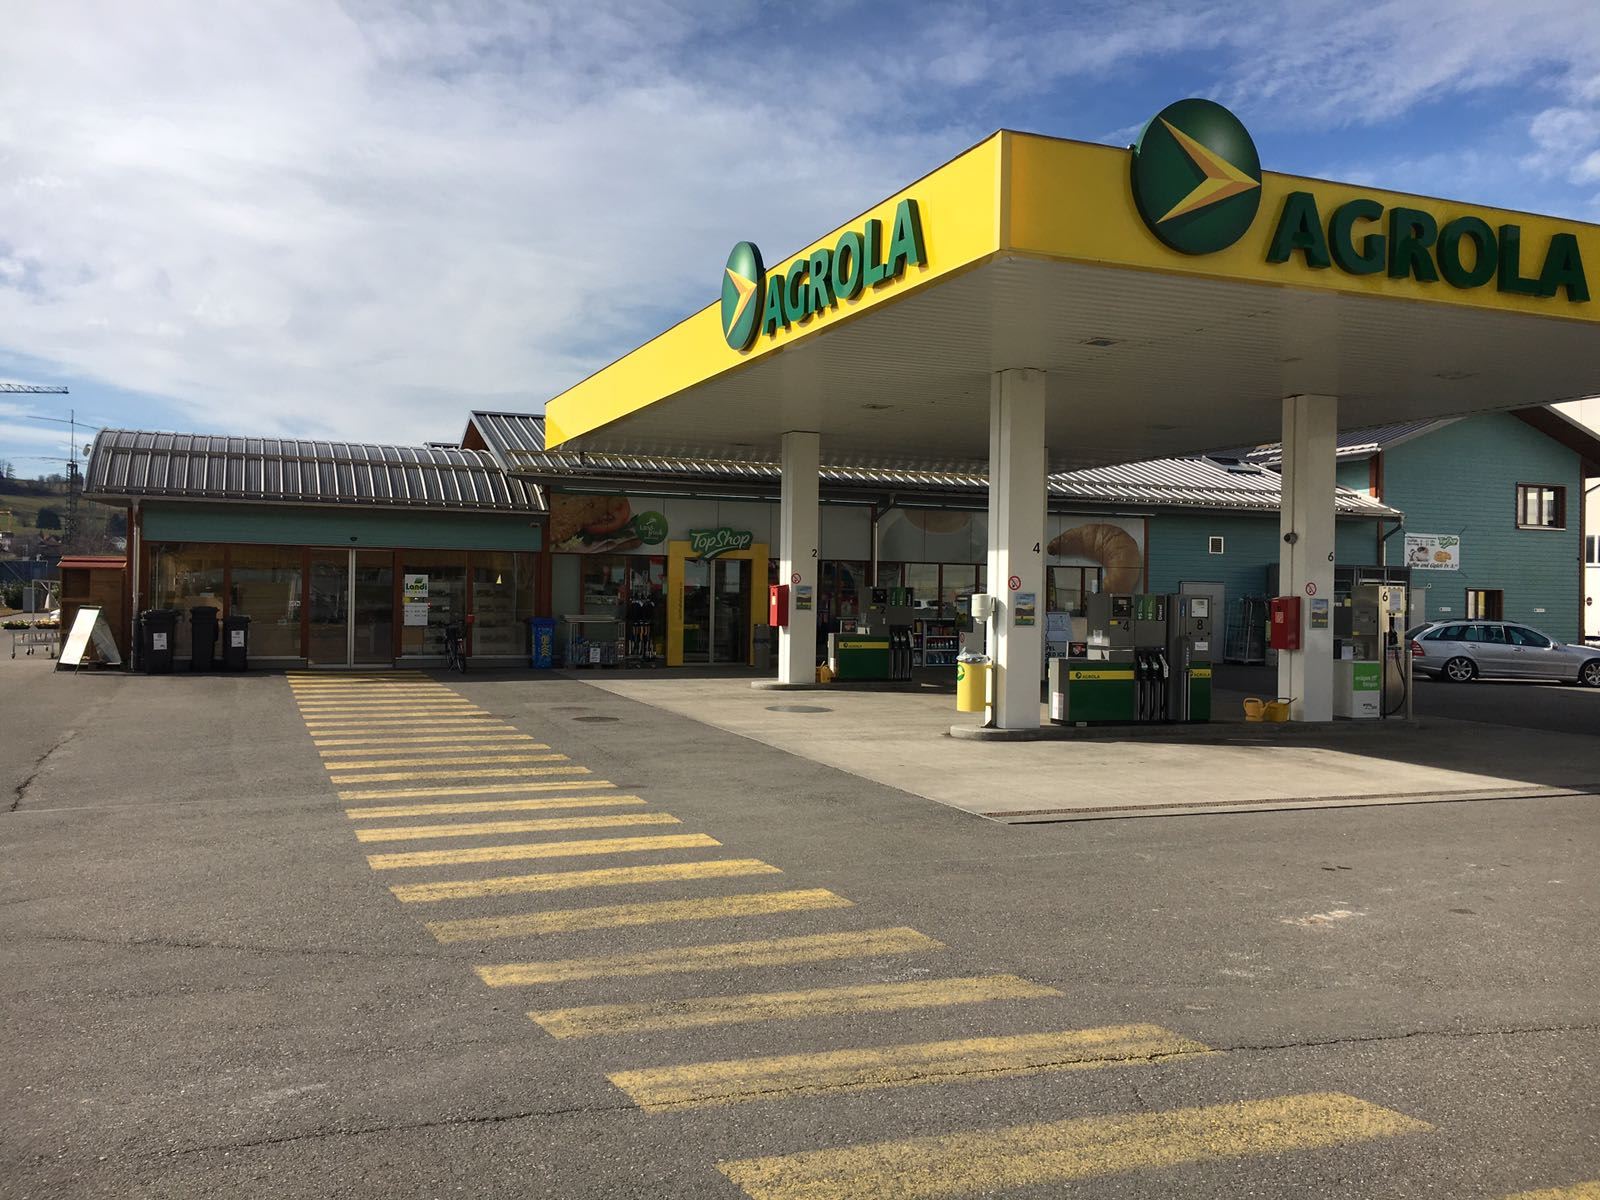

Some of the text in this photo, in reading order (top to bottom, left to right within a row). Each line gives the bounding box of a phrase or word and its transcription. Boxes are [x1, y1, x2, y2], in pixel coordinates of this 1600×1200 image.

[1266, 191, 1591, 303] AGROLA
[762, 198, 927, 337] AGROLA
[811, 548, 818, 558] 2
[1033, 542, 1041, 554] 4
[1328, 551, 1334, 562] 6
[1382, 591, 1389, 602] 6
[1122, 620, 1129, 632] 4
[1197, 619, 1203, 631] 8
